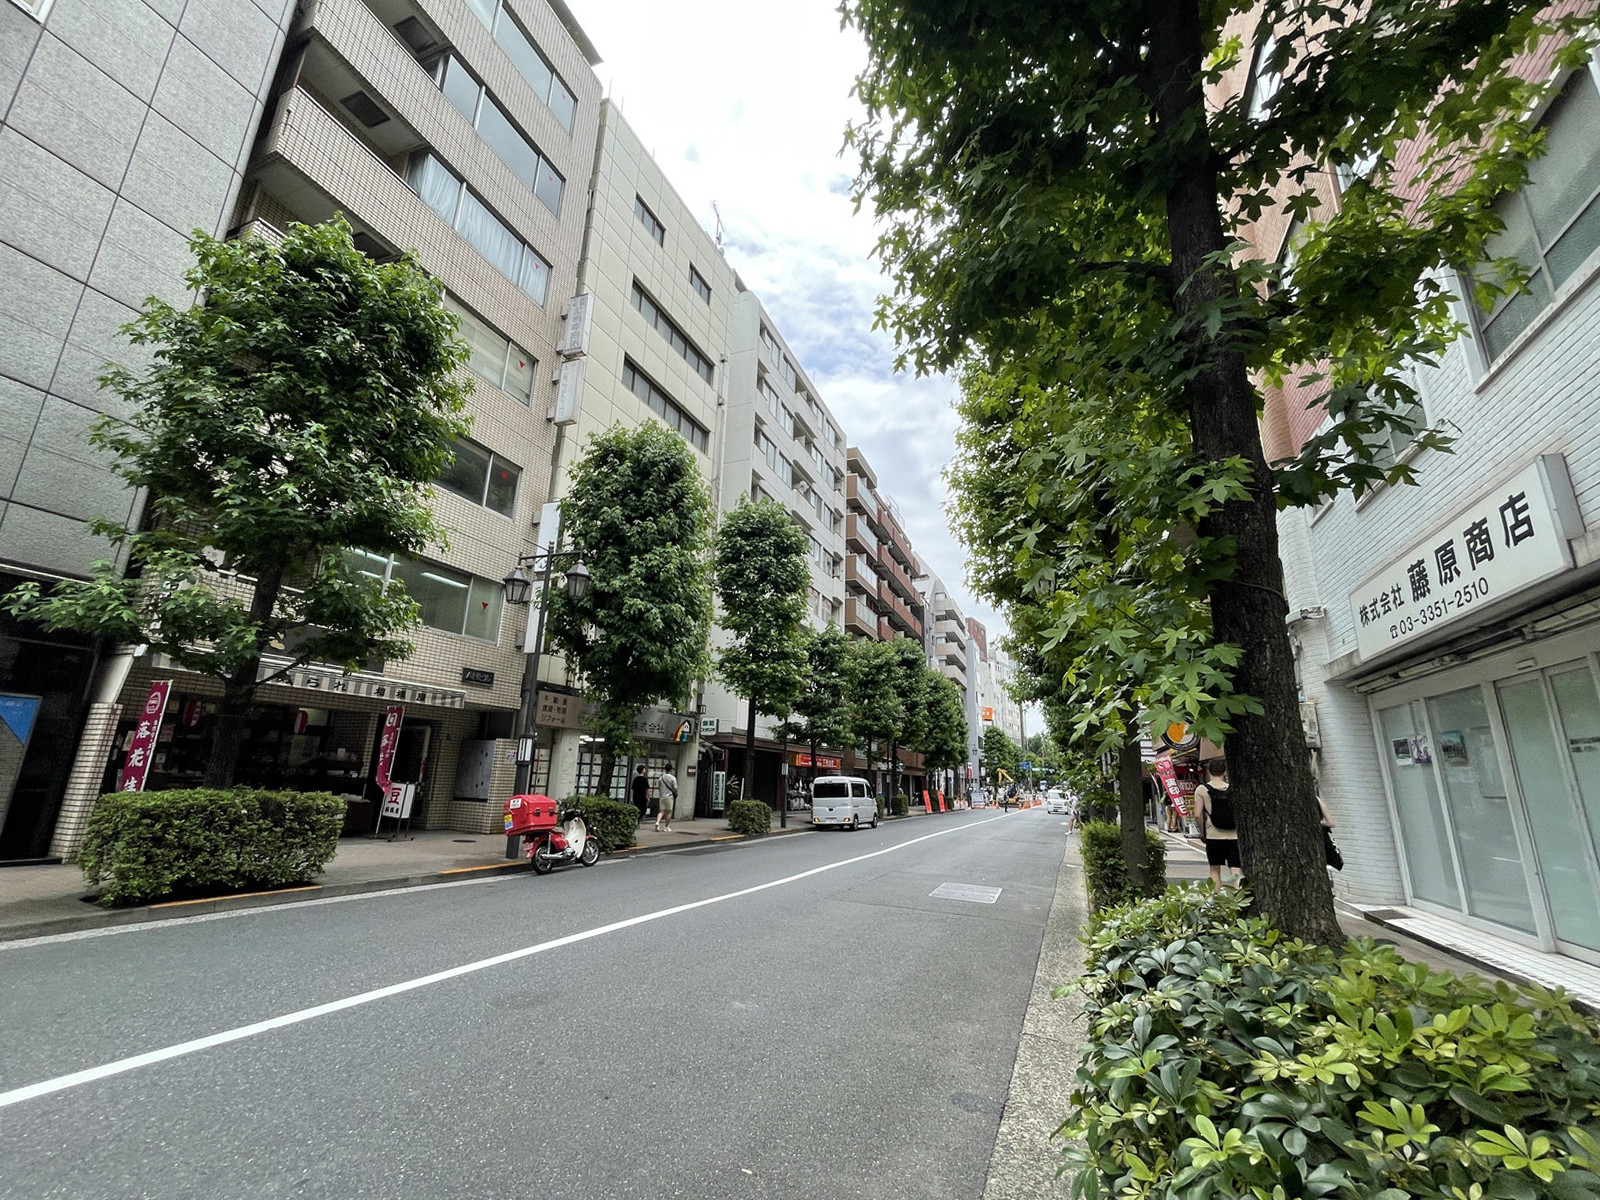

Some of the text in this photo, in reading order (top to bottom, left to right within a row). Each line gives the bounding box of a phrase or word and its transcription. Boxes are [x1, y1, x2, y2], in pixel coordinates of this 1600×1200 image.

[1359, 491, 1535, 628] 株式会社 藤原商店
[1399, 577, 1490, 636] 03-3351-2510
[541, 714, 566, 724] リフォーム
[387, 787, 402, 805] 豆
